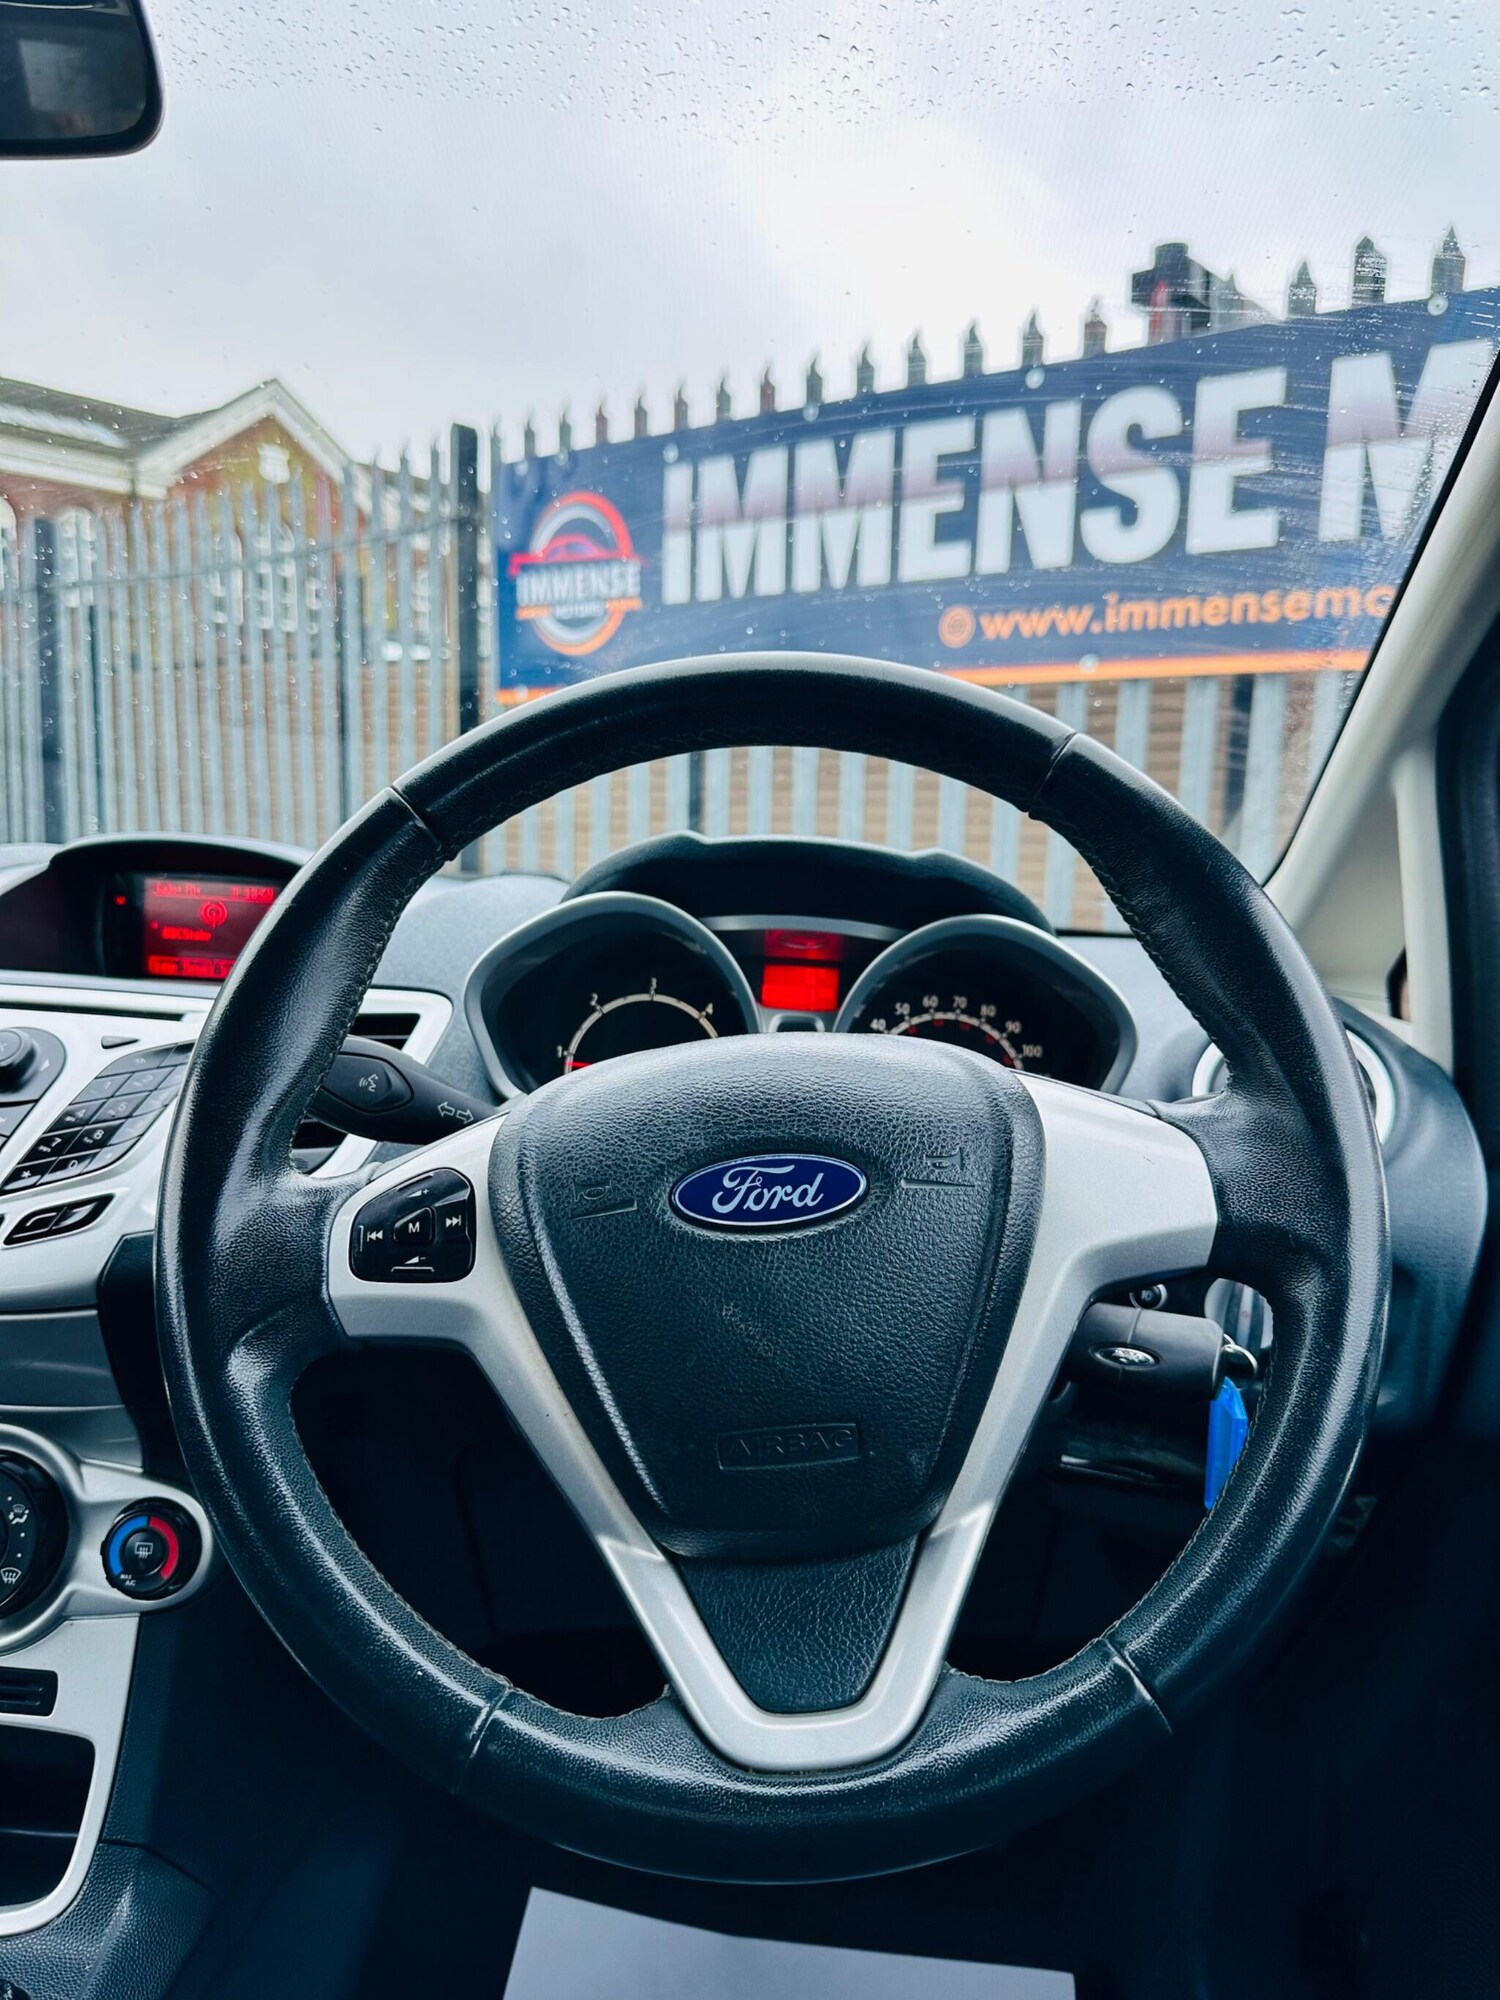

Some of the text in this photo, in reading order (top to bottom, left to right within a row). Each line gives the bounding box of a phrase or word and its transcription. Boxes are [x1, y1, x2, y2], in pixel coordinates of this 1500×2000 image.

[662, 338, 1492, 604] IMMENSE M
[516, 559, 641, 607] IMMENSE
[922, 995, 939, 1008] 60
[953, 996, 968, 1009] 70
[894, 1002, 911, 1016] 50
[980, 1004, 996, 1018] 80
[870, 1018, 887, 1032] 40
[1005, 1020, 1022, 1034] 90
[1022, 1044, 1043, 1058] 100
[93, 1129, 104, 1140] 8
[51, 1137, 62, 1147] 7
[68, 1159, 78, 1170] 0
[712, 1164, 825, 1214] Ford
[408, 1221, 420, 1234] M
[728, 1429, 852, 1456] AIRBAG
